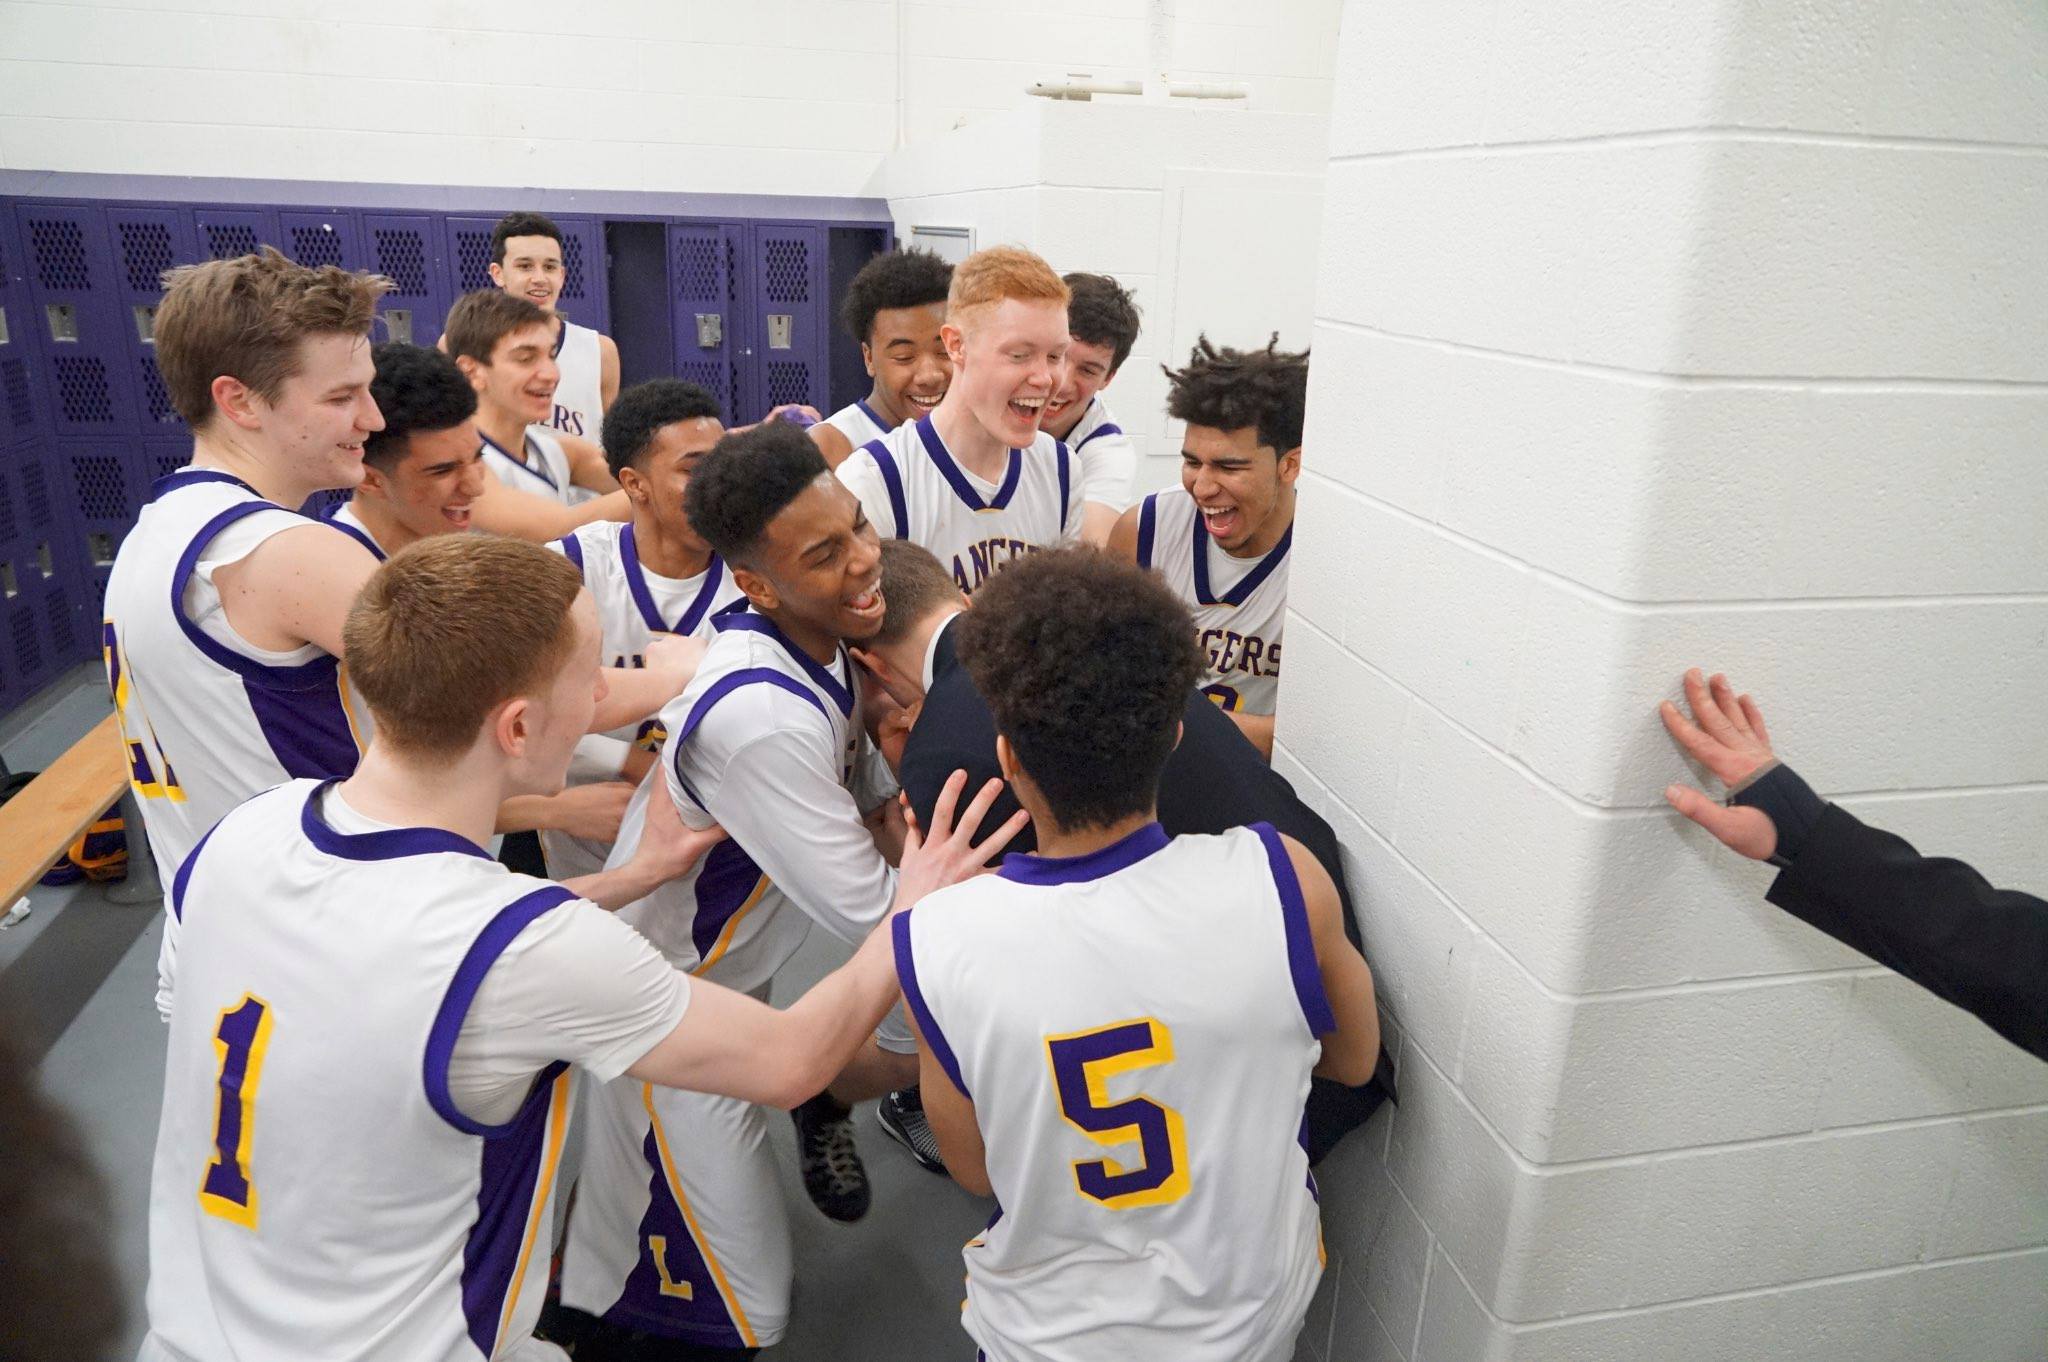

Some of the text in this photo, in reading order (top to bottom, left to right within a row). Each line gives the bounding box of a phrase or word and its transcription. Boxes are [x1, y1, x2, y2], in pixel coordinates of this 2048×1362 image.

[540, 404, 584, 437] RS
[1195, 628, 1282, 677] GERS
[199, 991, 274, 1231] 1
[1045, 1018, 1191, 1210] 5
[648, 1234, 693, 1301] L
